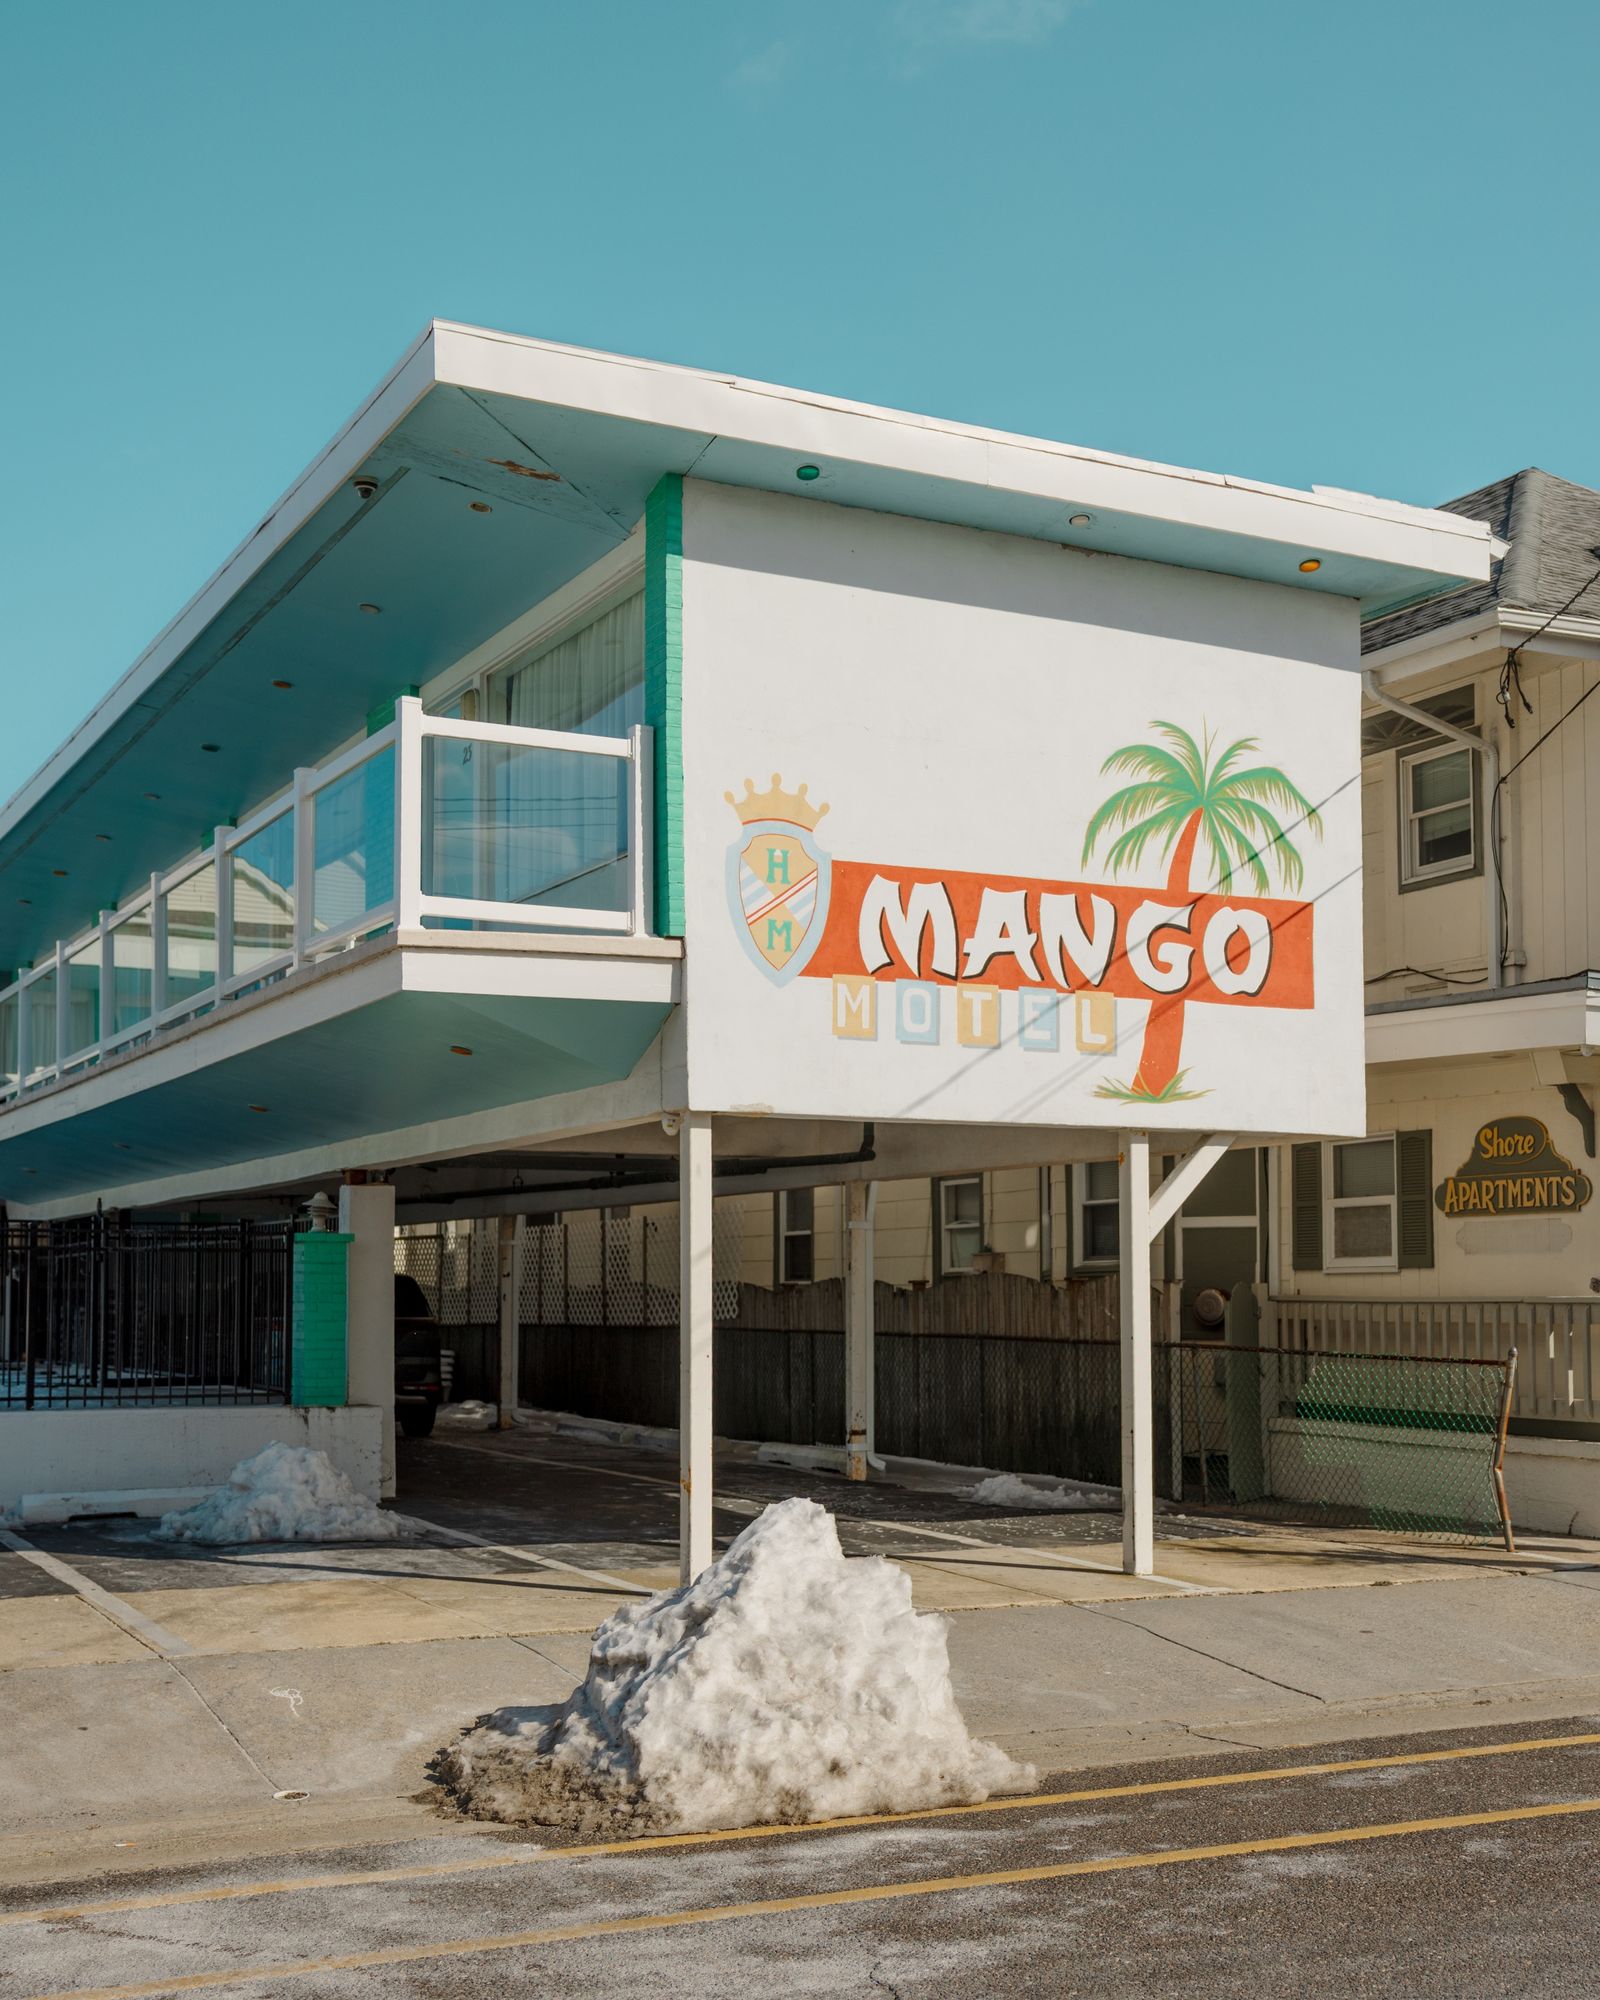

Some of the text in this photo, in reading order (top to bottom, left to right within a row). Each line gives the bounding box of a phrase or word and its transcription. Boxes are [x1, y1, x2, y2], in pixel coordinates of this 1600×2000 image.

[462, 742, 473, 766] 25
[766, 848, 791, 885] H
[767, 919, 793, 952] M
[858, 873, 1274, 996] MANGO
[836, 980, 1109, 1047] MOTEL
[1479, 1126, 1535, 1159] Shore
[1444, 1176, 1575, 1214] APARTMENTS
